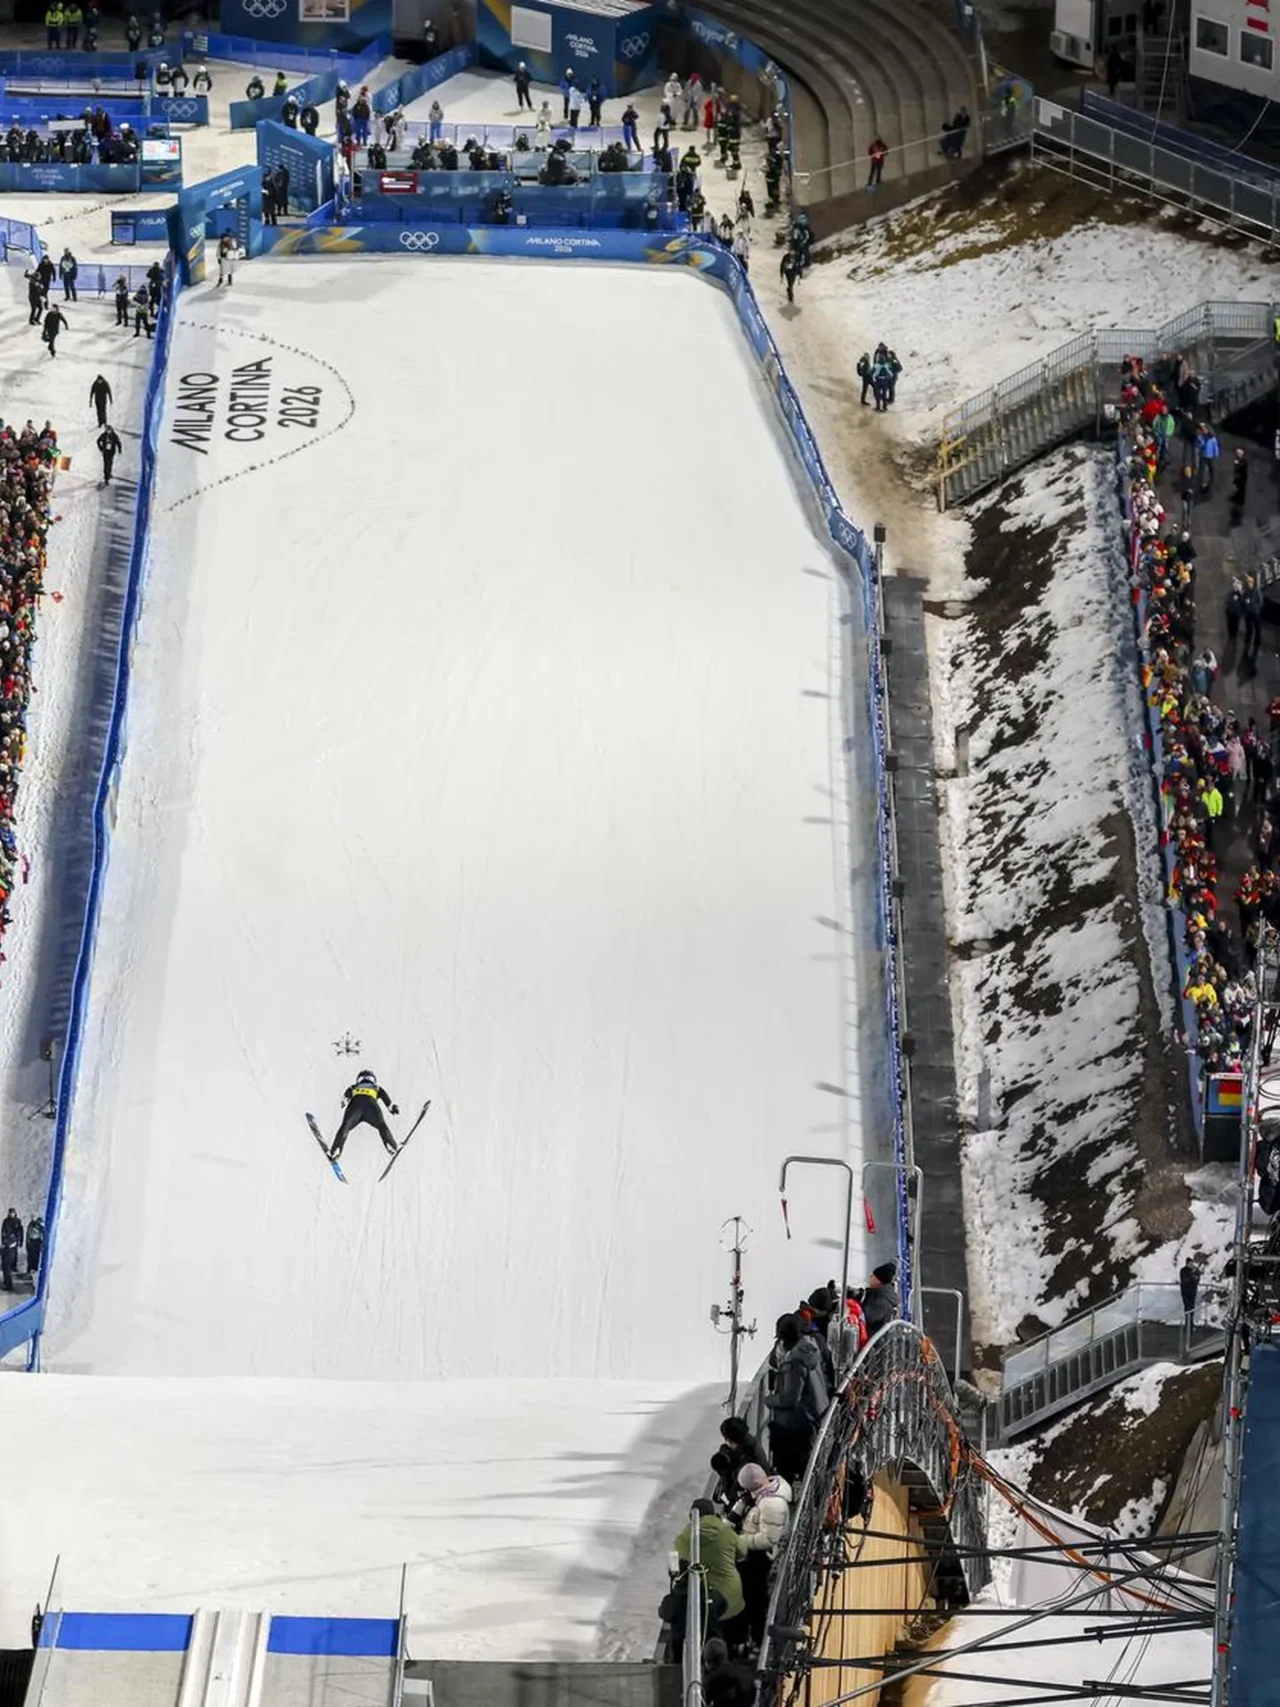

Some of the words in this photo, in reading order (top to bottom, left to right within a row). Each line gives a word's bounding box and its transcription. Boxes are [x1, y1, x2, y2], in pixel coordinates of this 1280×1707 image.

[525, 237, 562, 245] MILANO
[563, 238, 601, 247] CORTINA
[170, 372, 220, 455] MILANO
[224, 356, 273, 442] CORTINA
[277, 385, 323, 428] 2026
